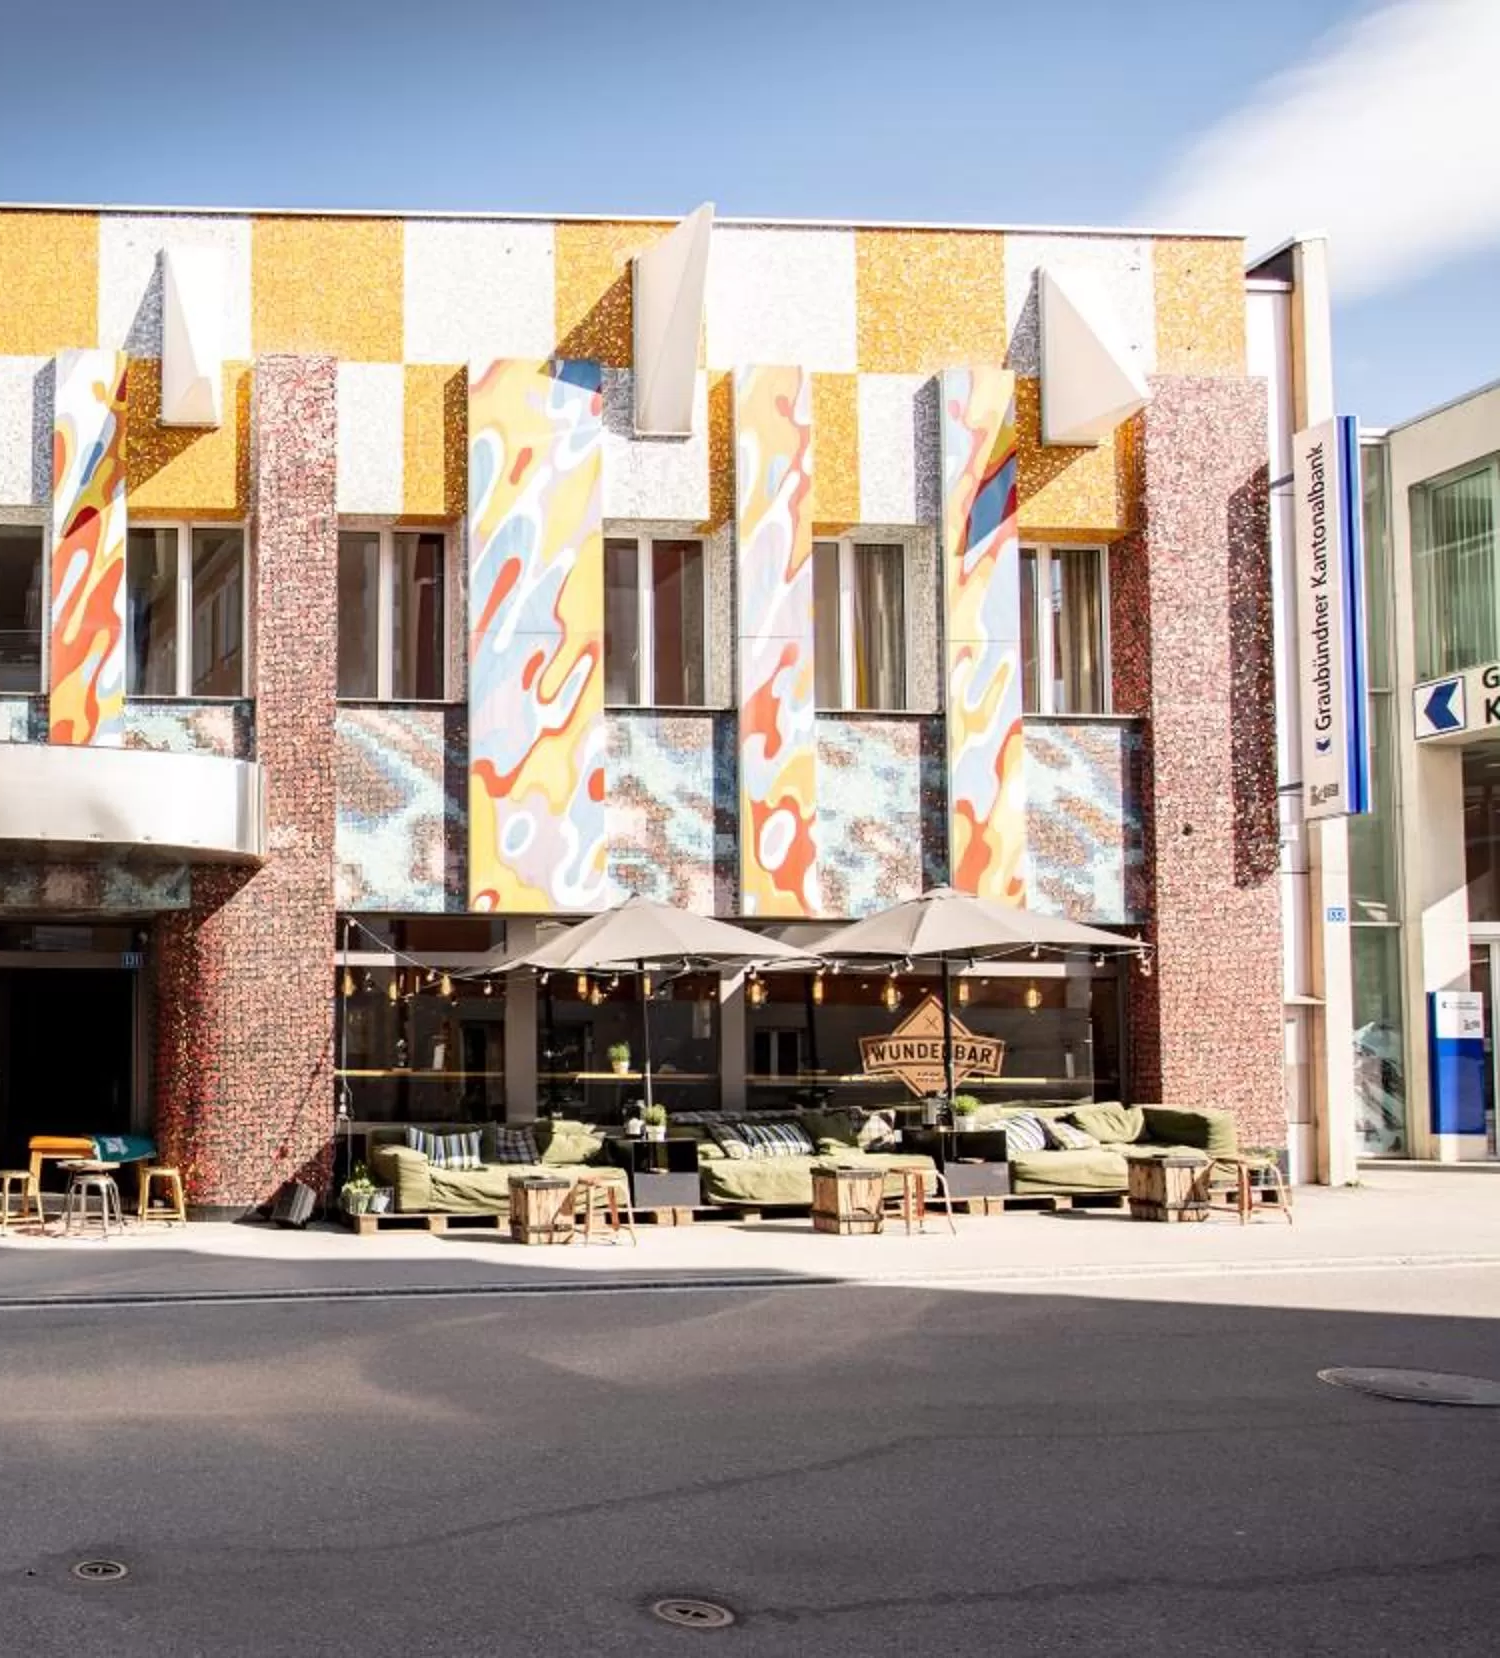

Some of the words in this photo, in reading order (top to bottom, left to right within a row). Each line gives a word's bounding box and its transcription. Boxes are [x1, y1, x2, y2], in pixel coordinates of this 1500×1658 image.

[1307, 442, 1329, 589] Kantonalbank
[1311, 594, 1332, 731] Graubündner
[871, 1042, 992, 1065] WUNDEBAR
